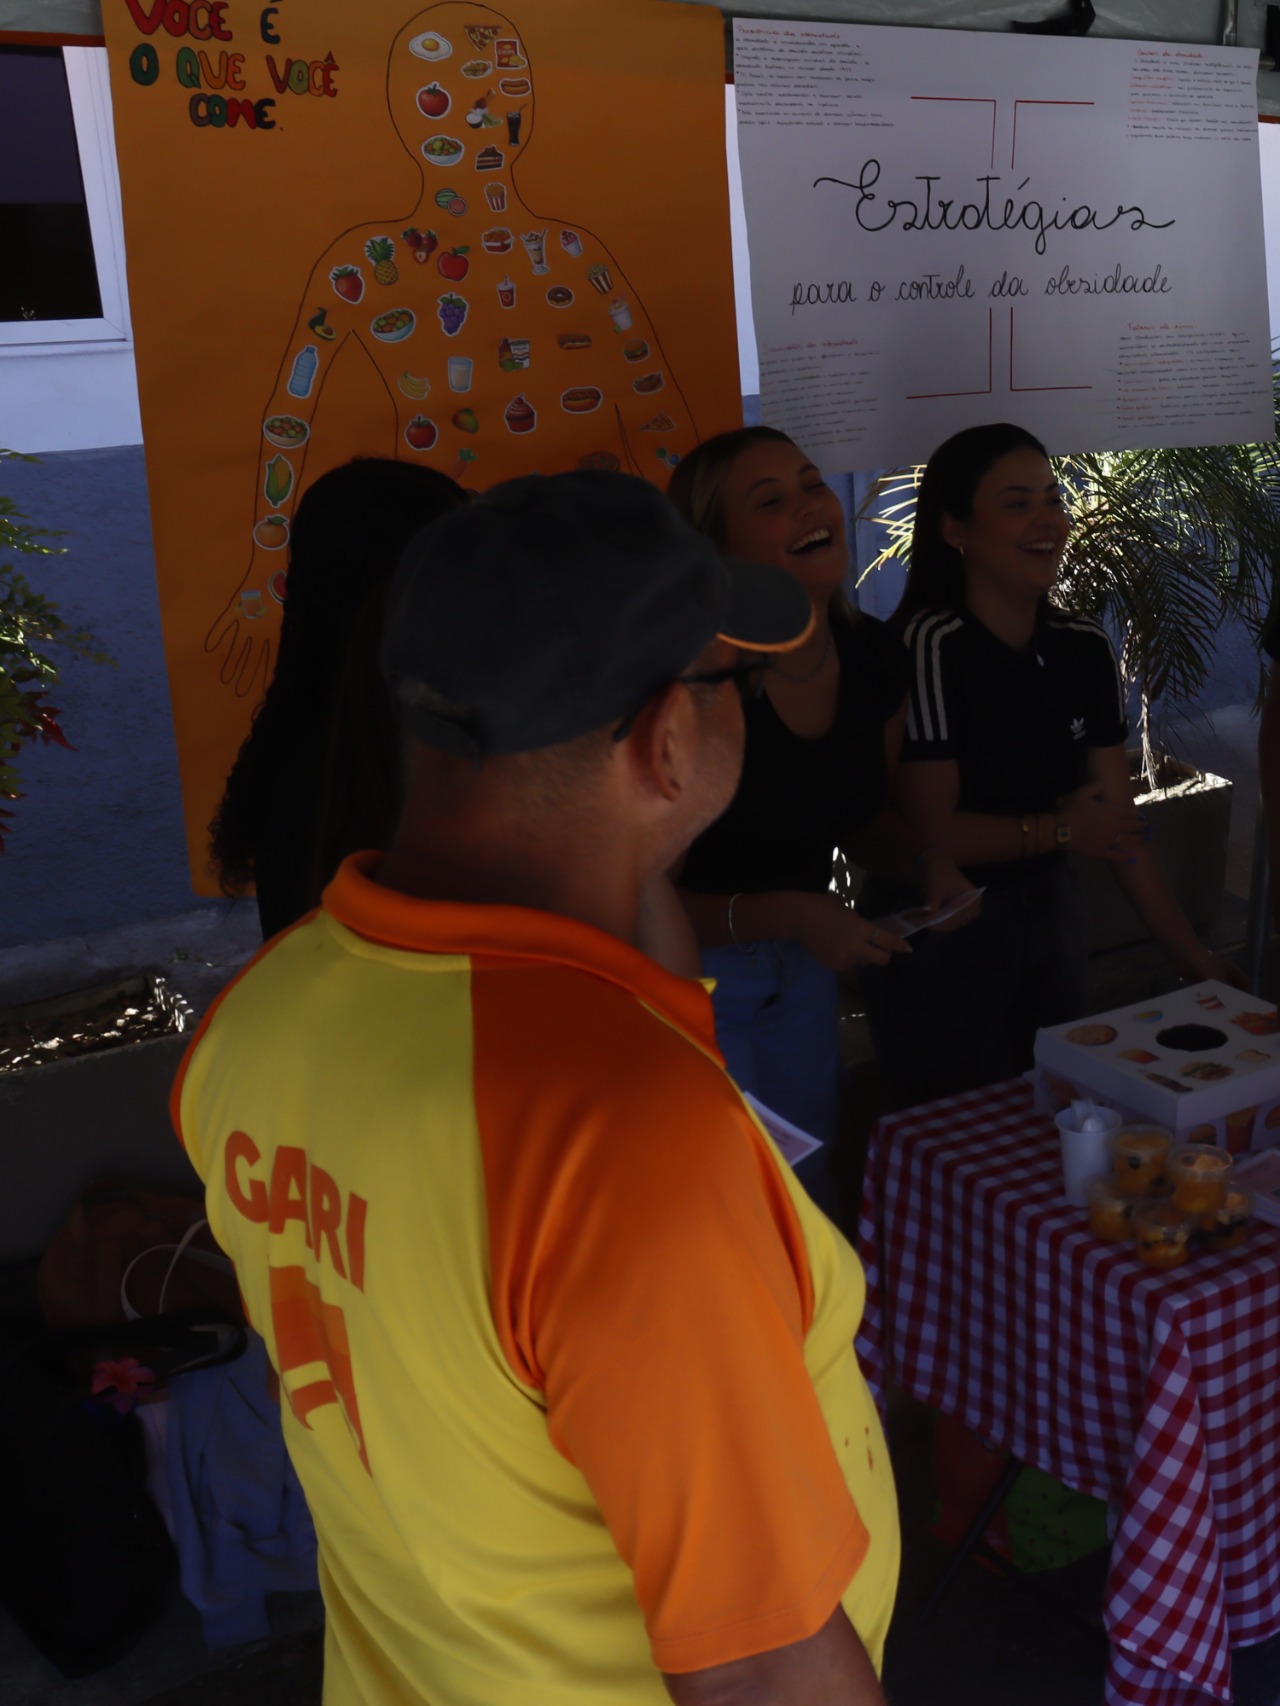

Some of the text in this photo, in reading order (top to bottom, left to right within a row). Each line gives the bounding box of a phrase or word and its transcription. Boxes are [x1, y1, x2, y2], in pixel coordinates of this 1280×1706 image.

[130, 43, 339, 98] O QUE VOCÊ
[813, 159, 1176, 256] Estratégias
[788, 263, 1174, 316] para o controle da obesidade
[225, 1130, 368, 1296] GARI
